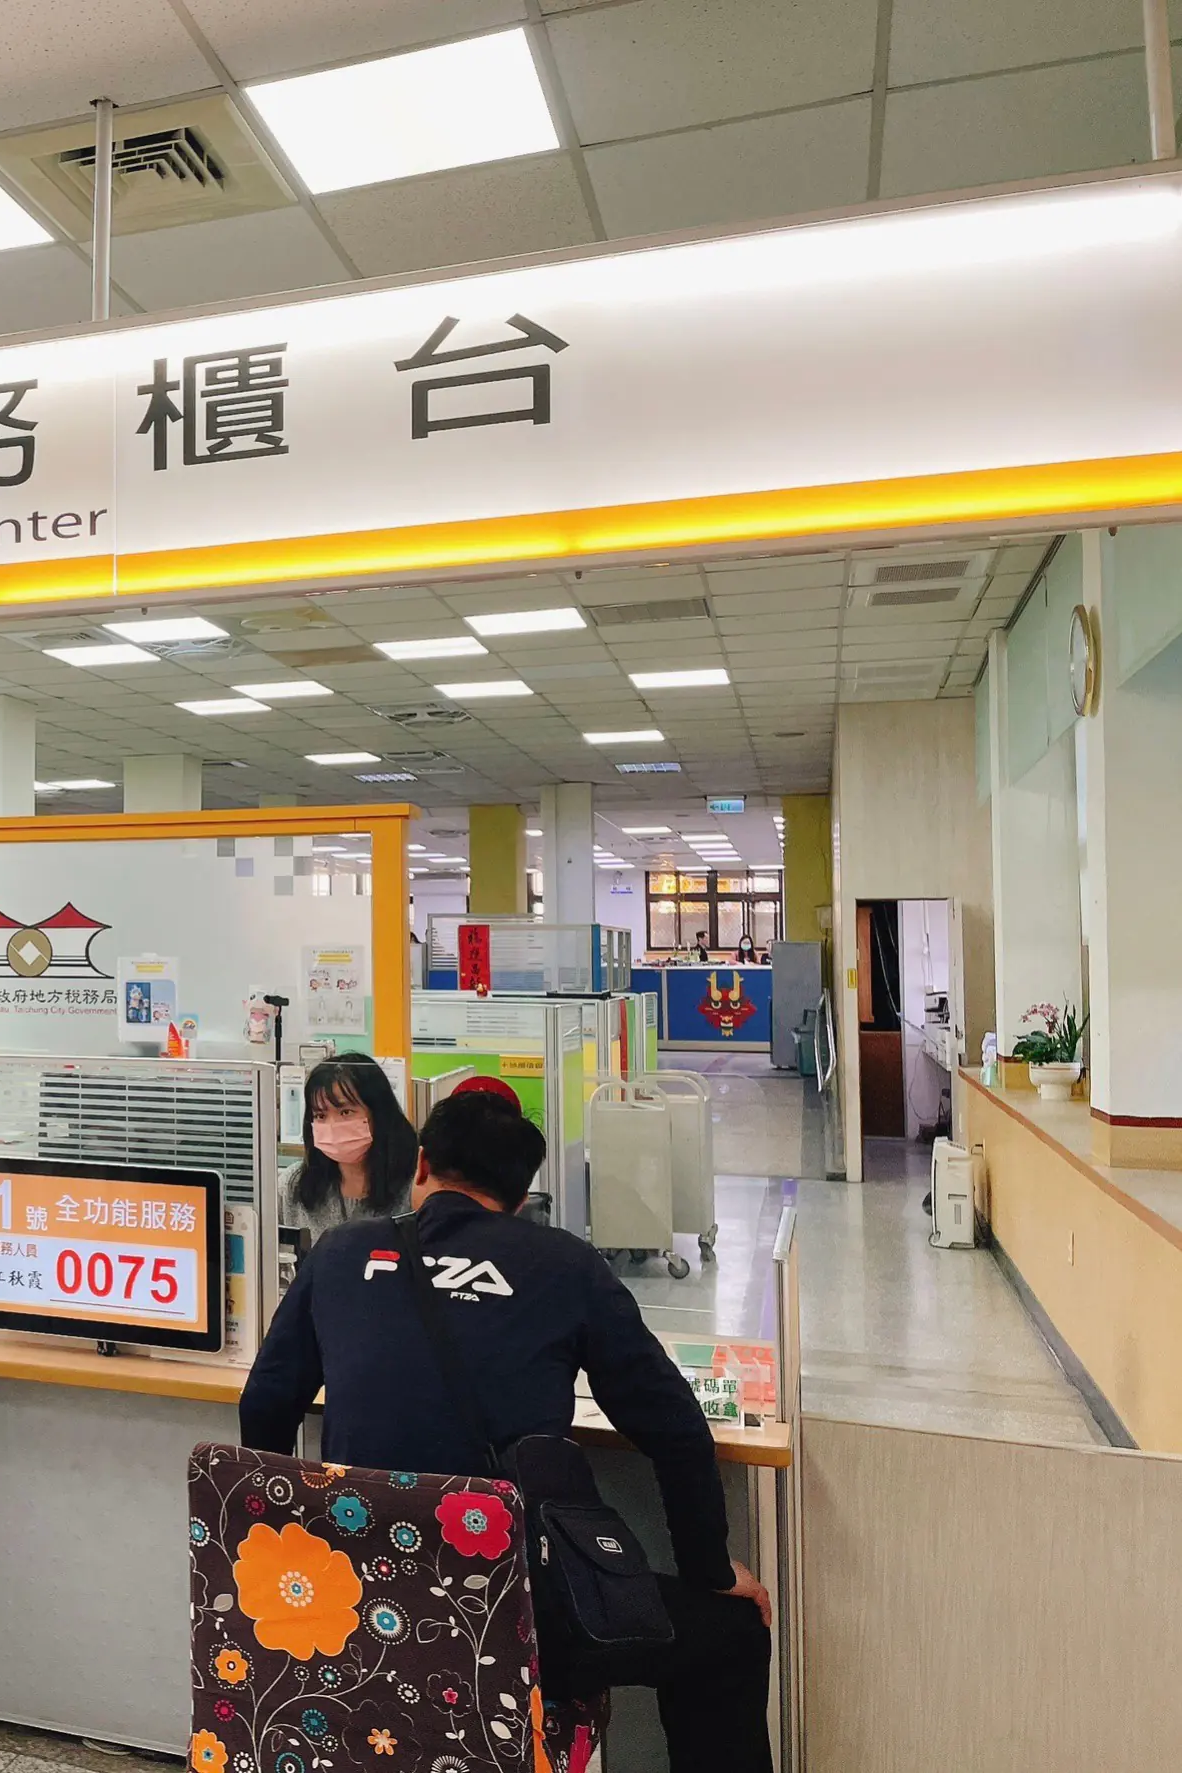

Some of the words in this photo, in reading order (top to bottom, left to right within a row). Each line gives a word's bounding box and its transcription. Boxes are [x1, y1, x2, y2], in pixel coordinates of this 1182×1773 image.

[14, 1005, 48, 1015] Taichung
[50, 1005, 65, 1015] City
[55, 1194, 198, 1233] 全功能服務
[56, 1248, 179, 1305] 0075
